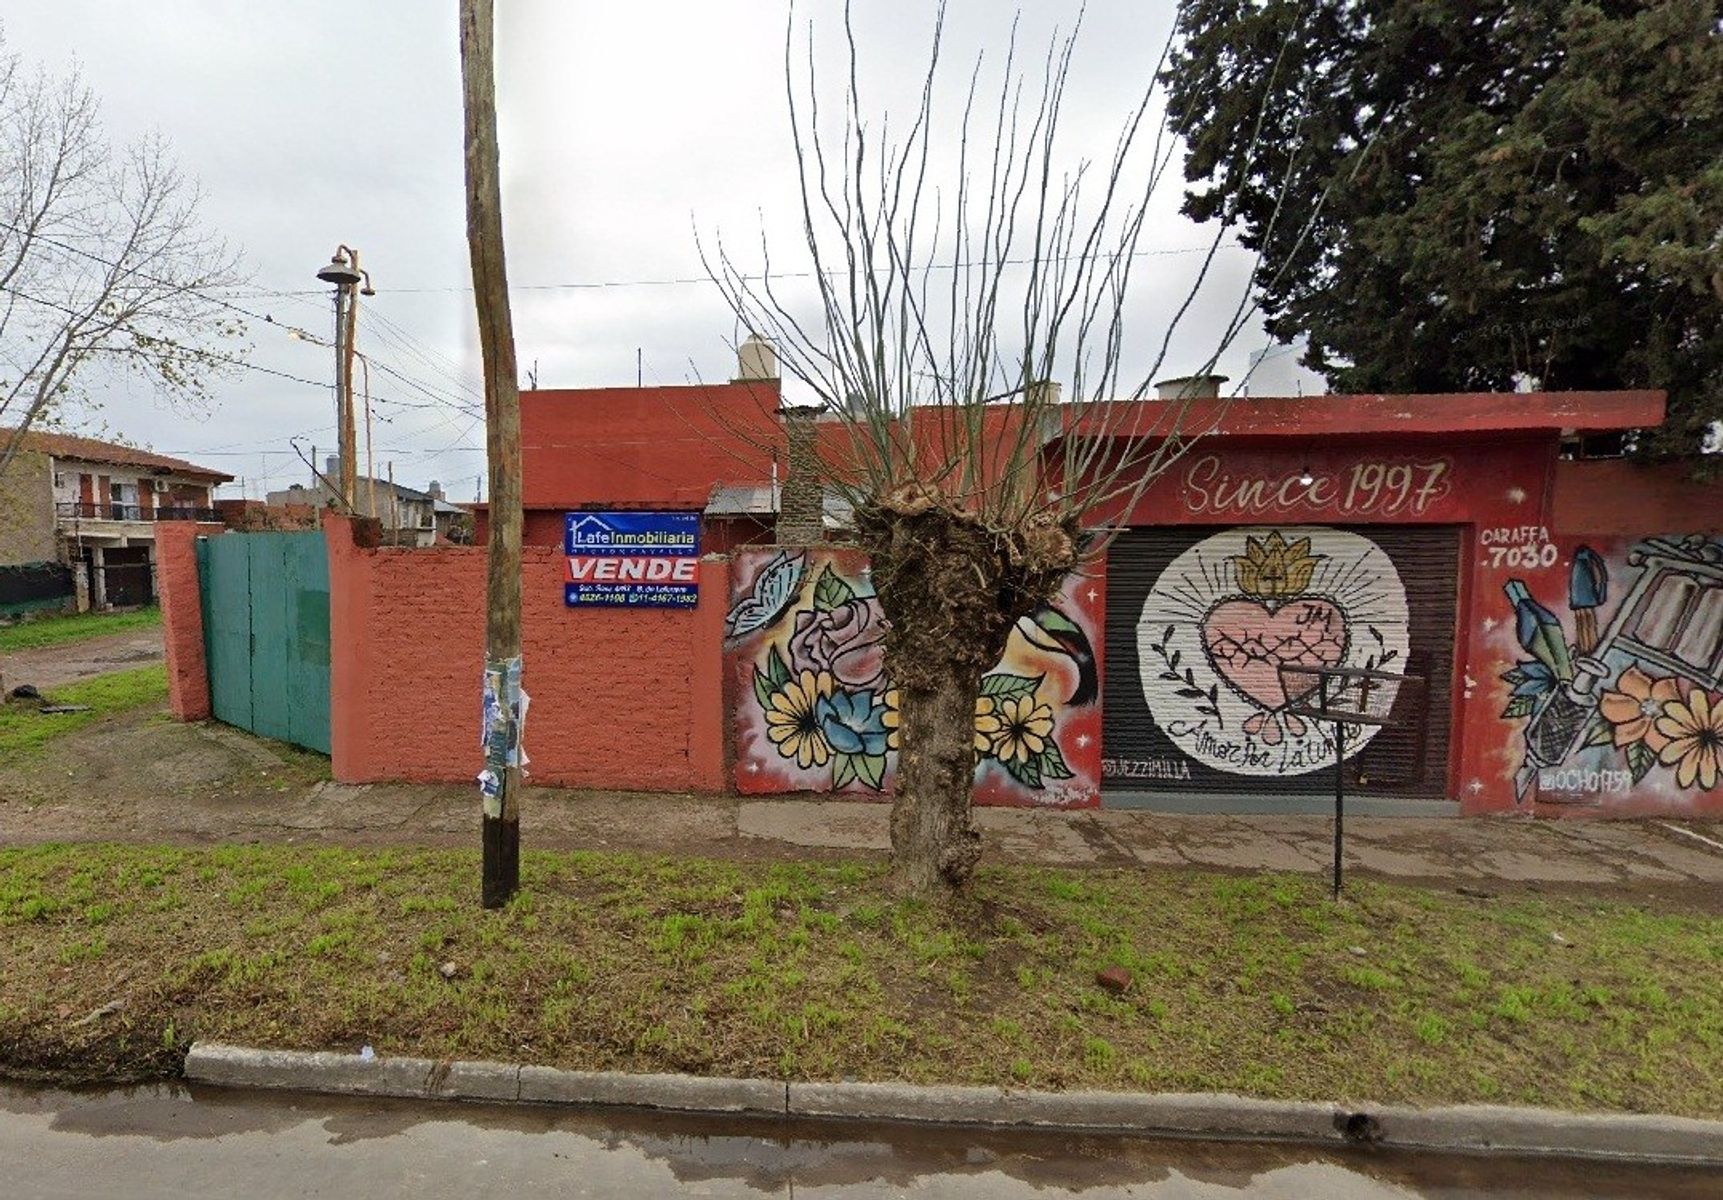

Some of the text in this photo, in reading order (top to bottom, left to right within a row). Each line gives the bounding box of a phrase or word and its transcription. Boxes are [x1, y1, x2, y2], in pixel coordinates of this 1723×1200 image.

[1184, 455, 1447, 512] Since 1997
[569, 558, 697, 580] VENDE
[1488, 542, 1558, 569] 7030
